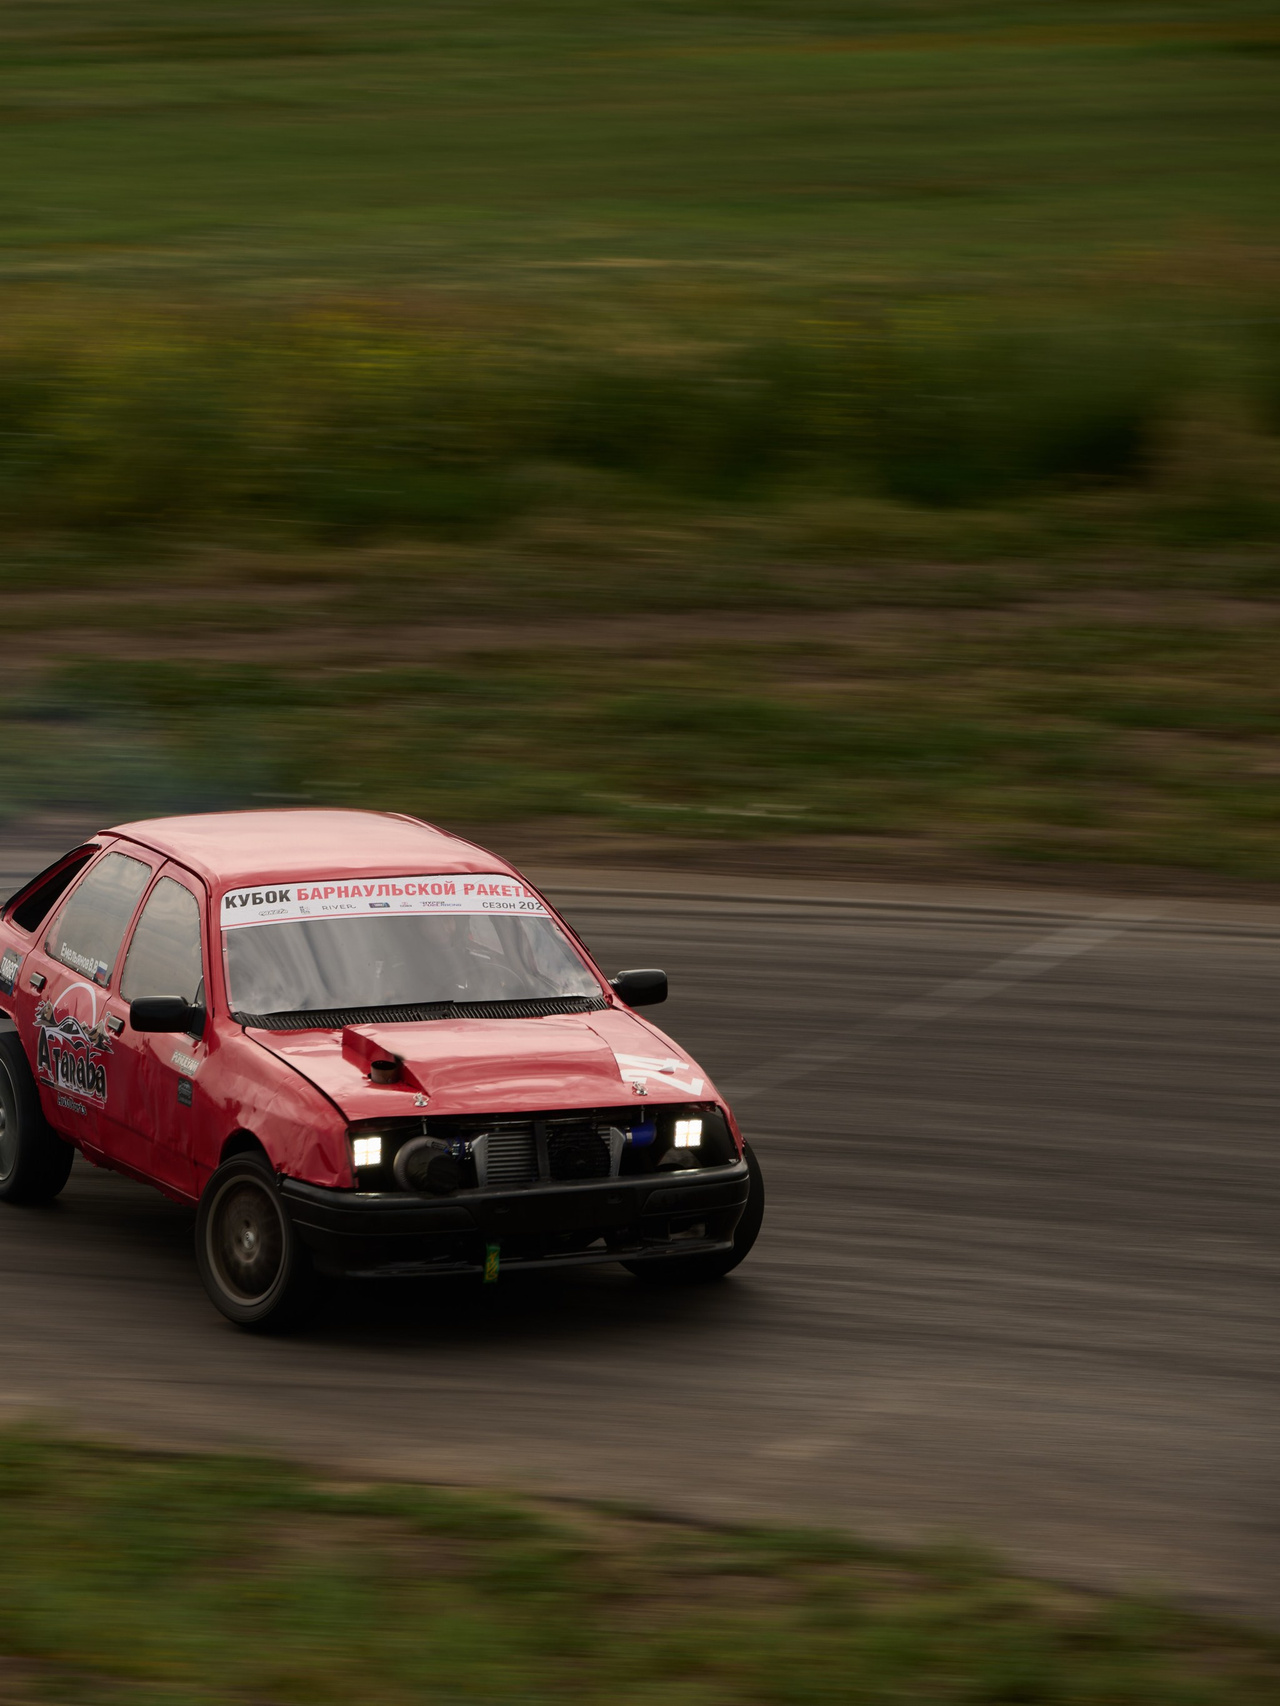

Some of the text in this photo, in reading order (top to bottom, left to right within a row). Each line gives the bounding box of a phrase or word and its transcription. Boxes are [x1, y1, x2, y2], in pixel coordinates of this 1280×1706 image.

[225, 889, 291, 909] КУБОК
[297, 880, 456, 901] БАРНАУЛЬСКОЙ
[482, 901, 516, 909] СЕЗОН
